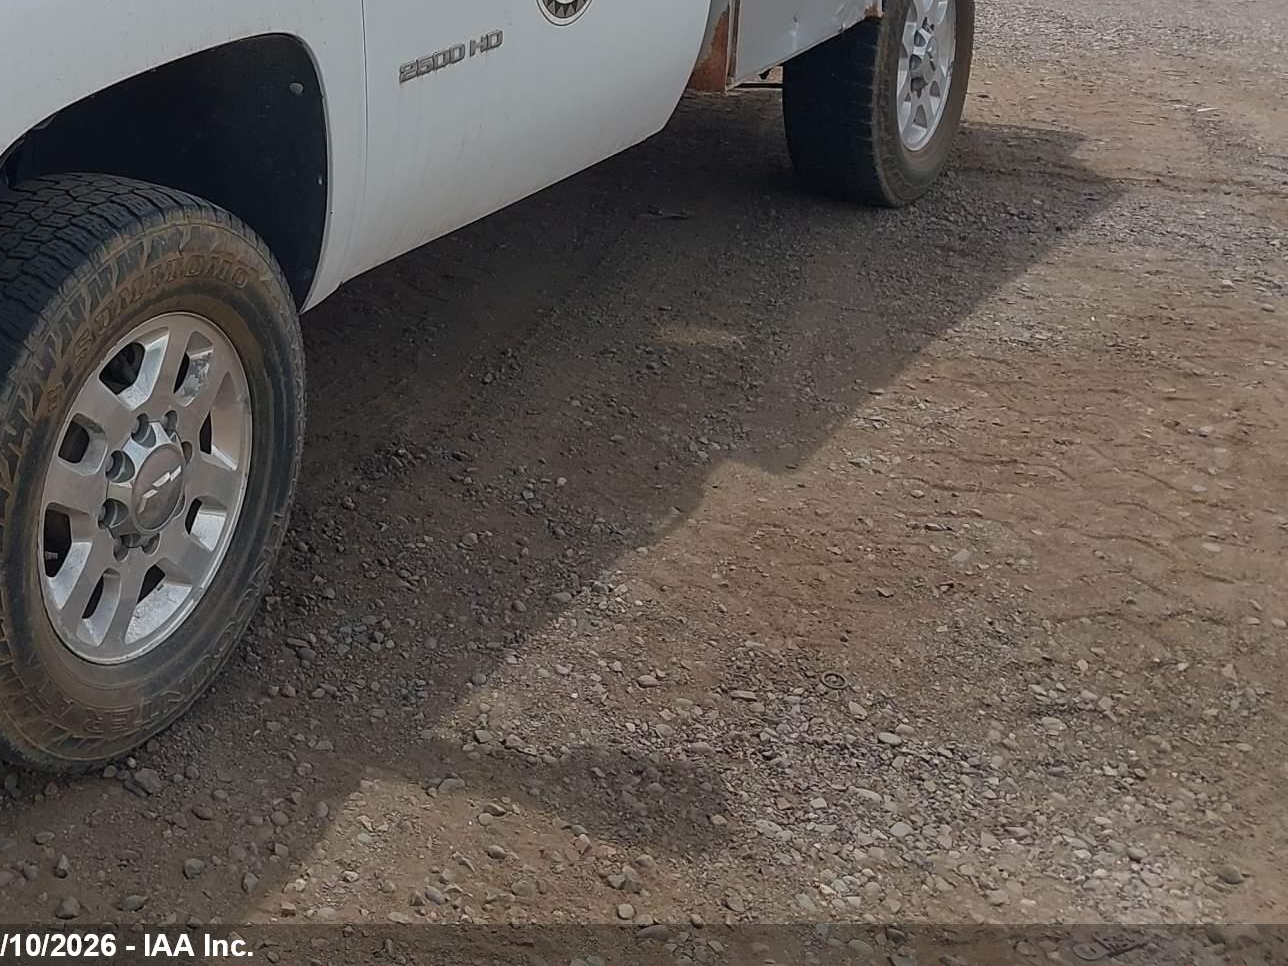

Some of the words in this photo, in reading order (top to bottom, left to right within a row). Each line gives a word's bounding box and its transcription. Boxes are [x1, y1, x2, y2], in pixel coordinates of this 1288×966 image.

[399, 42, 466, 83] 2500
[469, 29, 504, 57] HD
[74, 253, 250, 370] SUMITOMO
